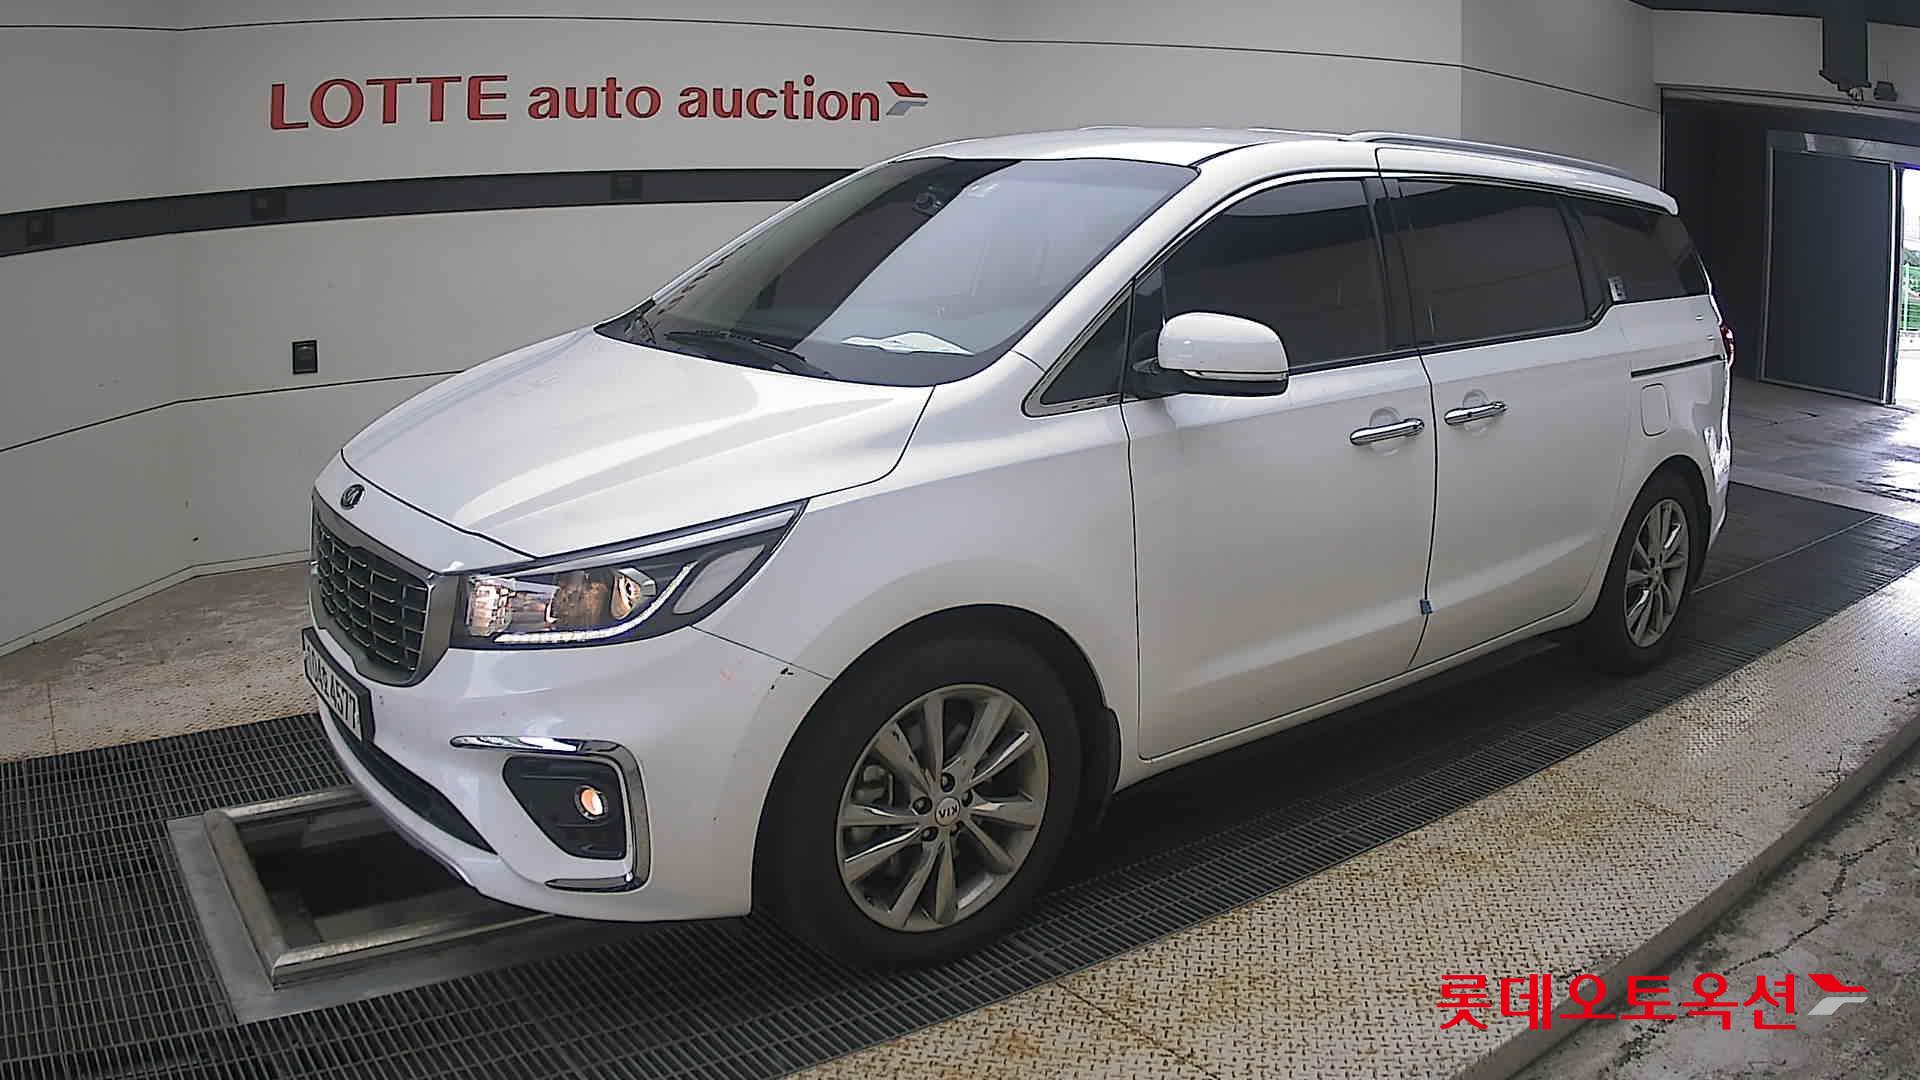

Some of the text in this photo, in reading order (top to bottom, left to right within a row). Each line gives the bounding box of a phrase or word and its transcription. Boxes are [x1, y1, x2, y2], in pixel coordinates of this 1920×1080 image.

[270, 75, 880, 130] LOTTE auto auction
[938, 805, 958, 818] KIA
